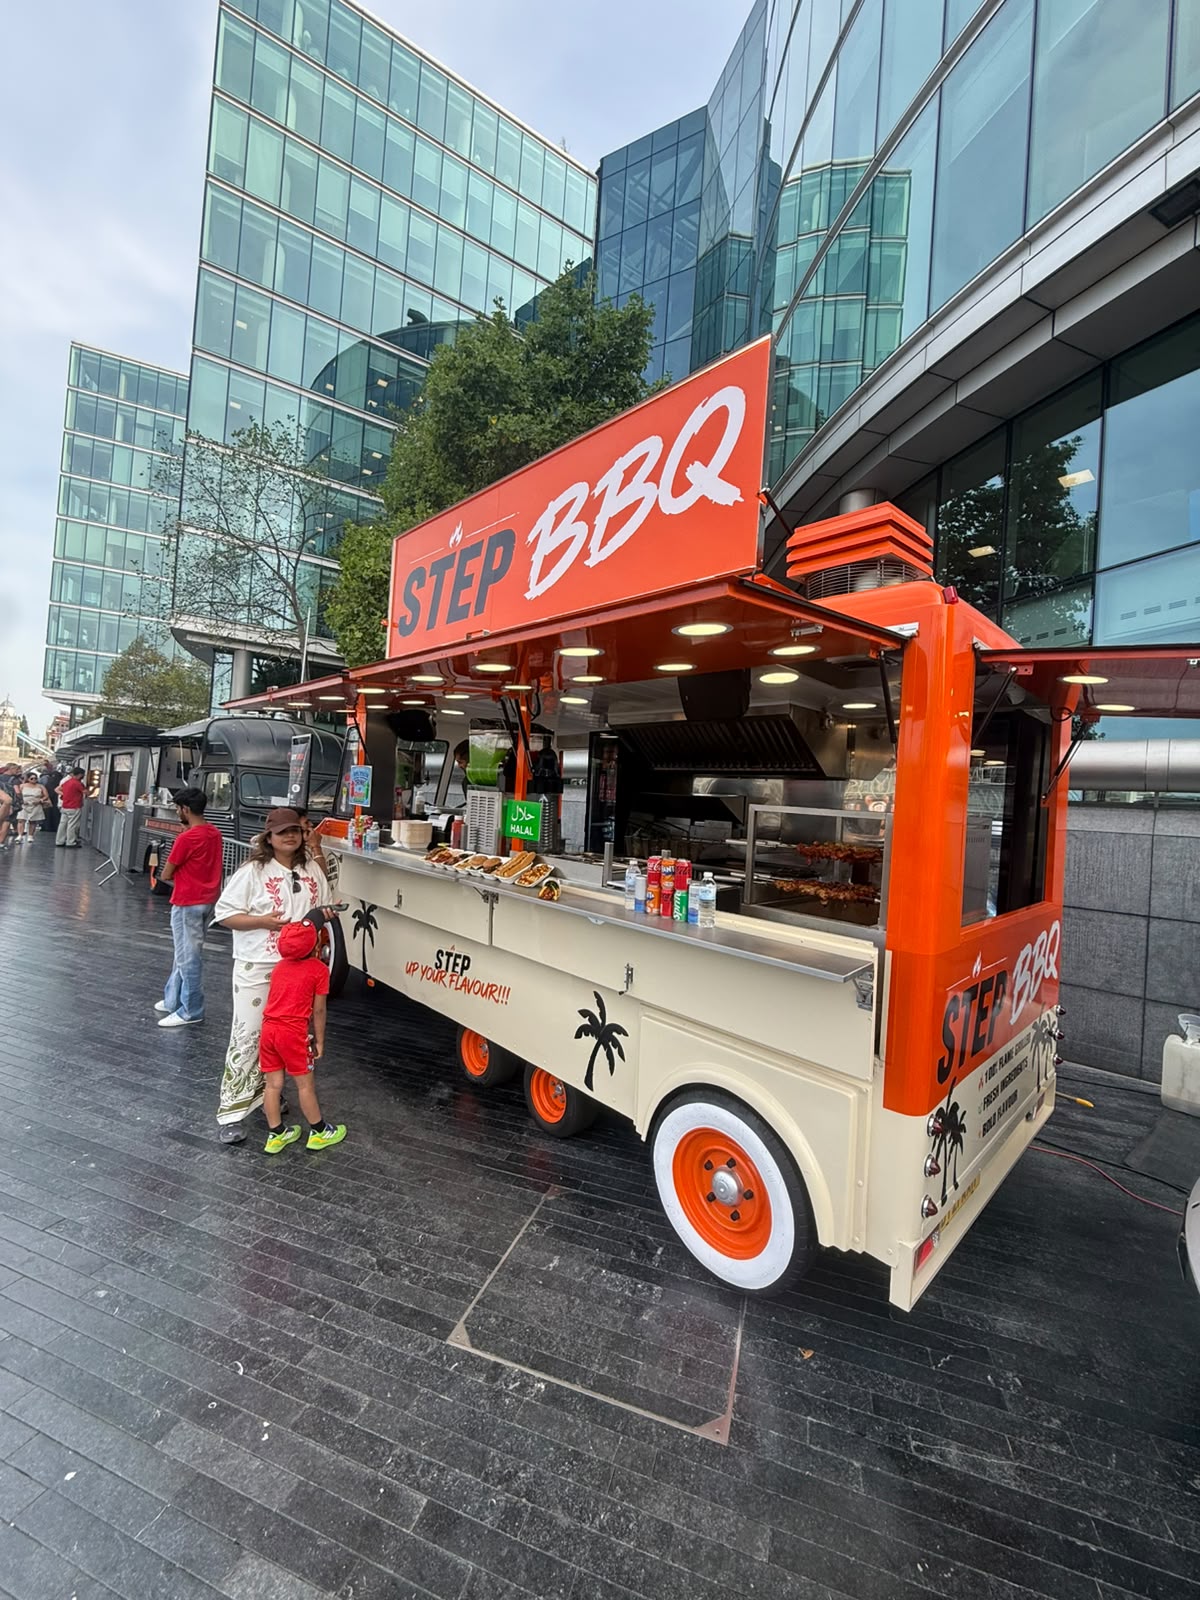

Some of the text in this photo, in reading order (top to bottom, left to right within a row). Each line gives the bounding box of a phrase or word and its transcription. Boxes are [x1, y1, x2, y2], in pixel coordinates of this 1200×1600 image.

[398, 386, 746, 637] STEP BBQ
[511, 804, 535, 821] حلال
[510, 823, 534, 836] HALAL
[434, 949, 471, 976] STEP
[405, 961, 511, 1005] UP YOUR FLAVOUR!!!
[937, 920, 1060, 1085] STEP BBQ
[983, 1084, 999, 1111] FRESH
